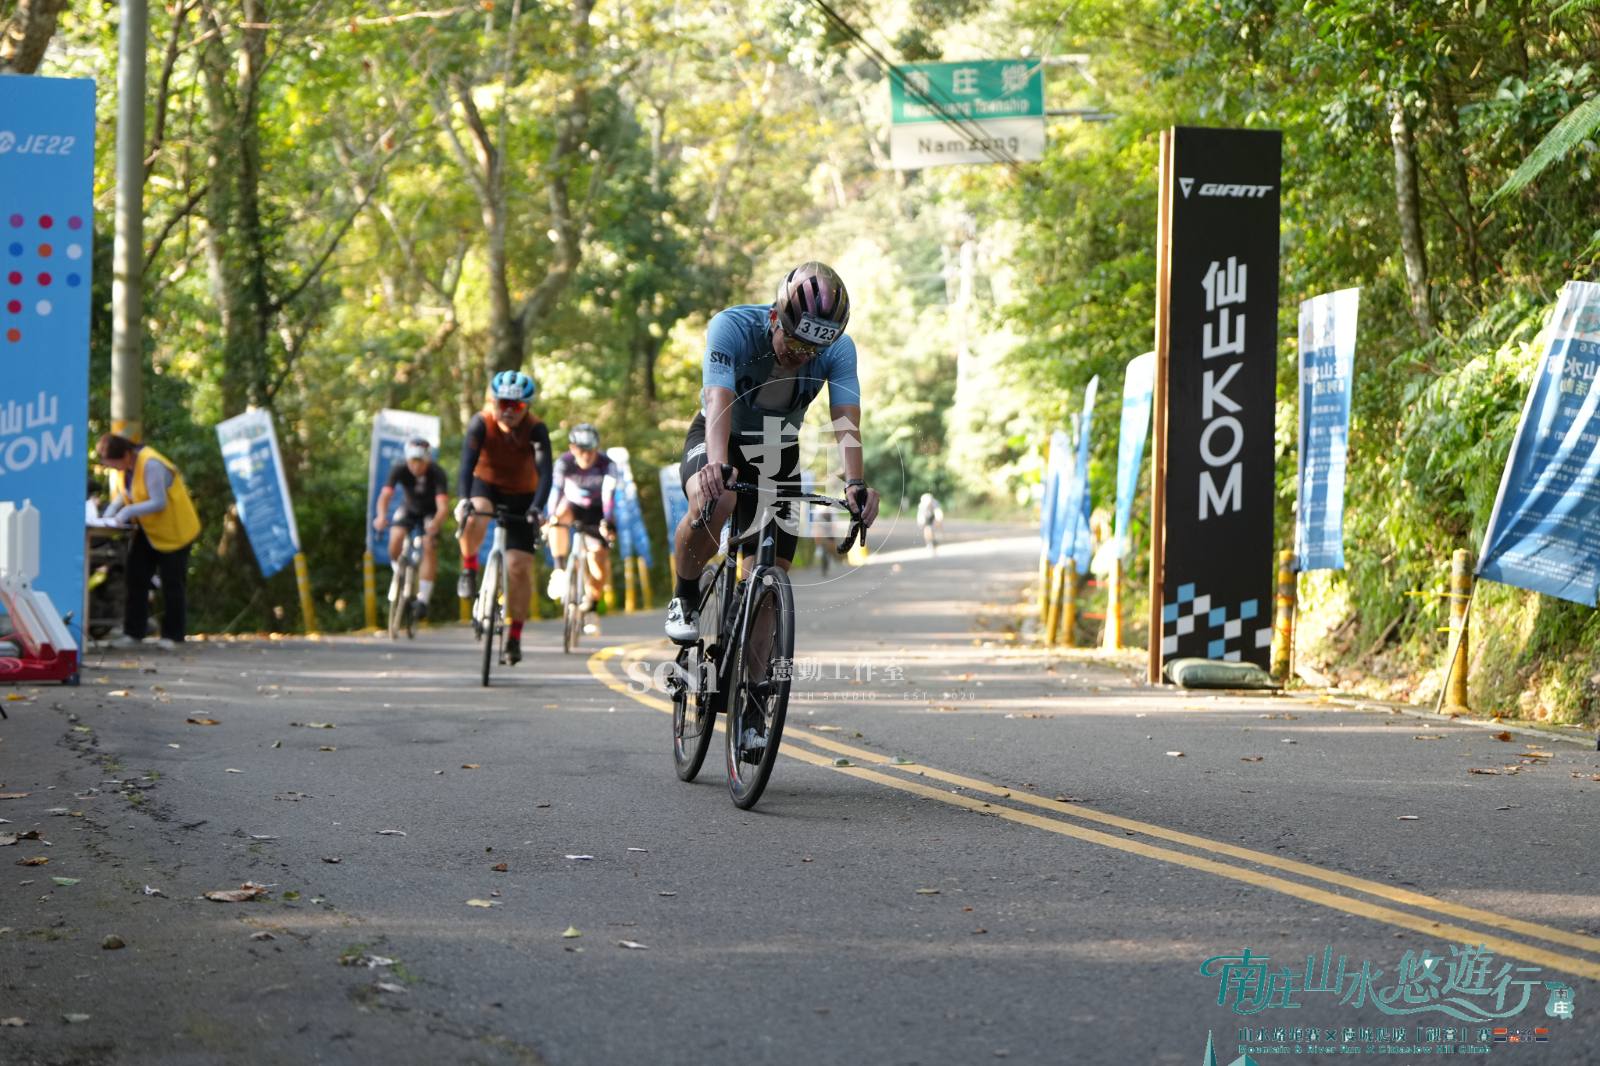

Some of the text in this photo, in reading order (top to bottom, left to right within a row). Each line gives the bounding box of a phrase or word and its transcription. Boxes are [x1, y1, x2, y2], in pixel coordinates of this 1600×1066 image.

[16, 134, 76, 155] JE22
[1199, 183, 1275, 198] GIANT
[0, 425, 73, 475] OM
